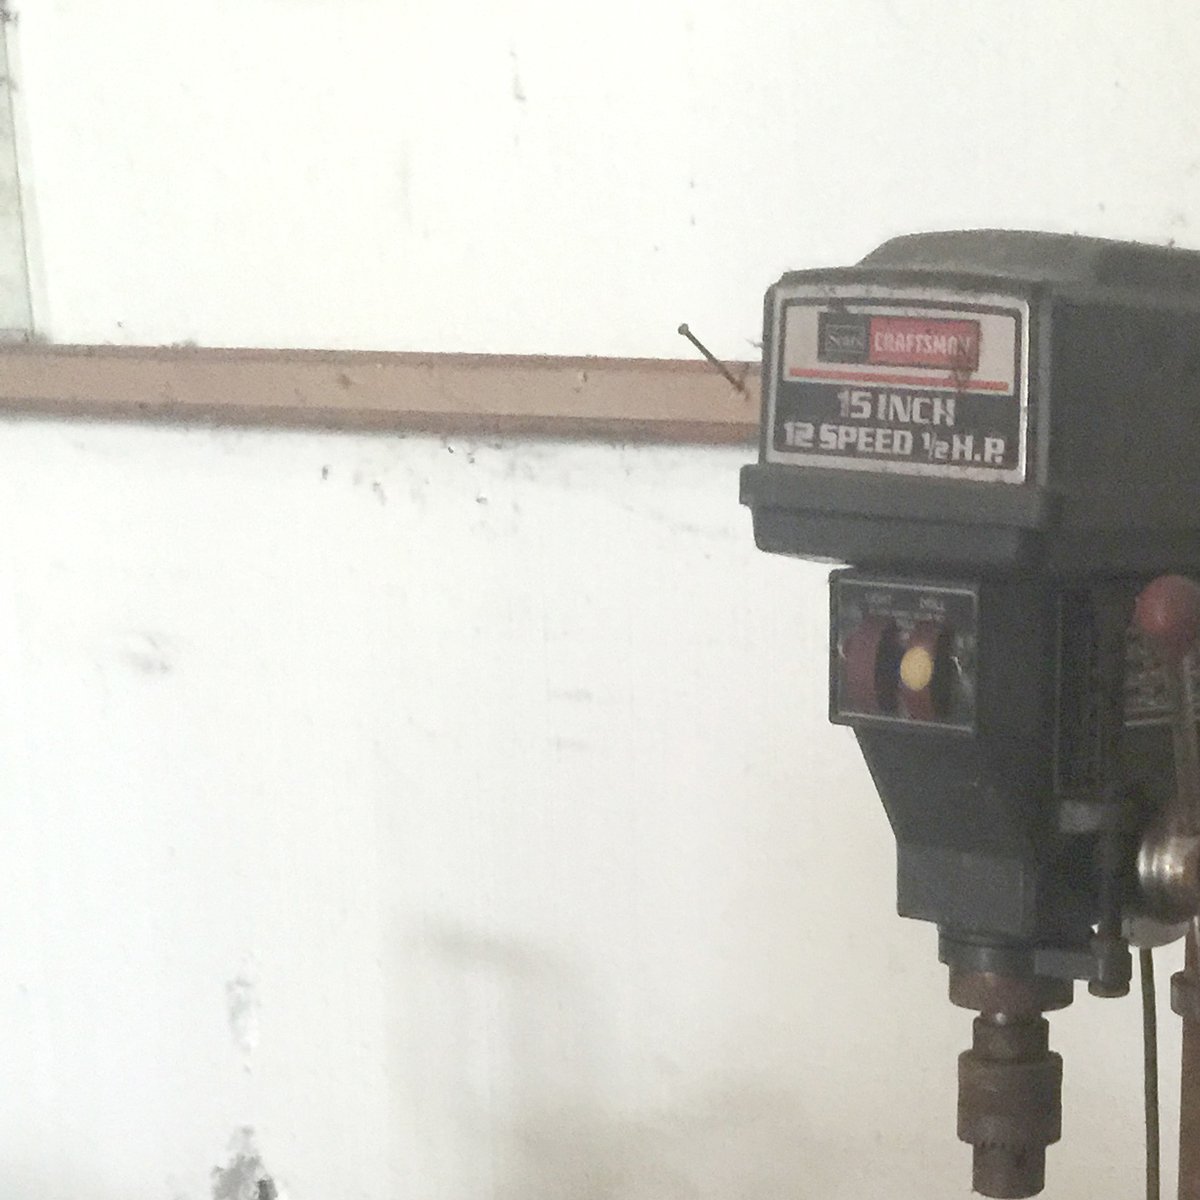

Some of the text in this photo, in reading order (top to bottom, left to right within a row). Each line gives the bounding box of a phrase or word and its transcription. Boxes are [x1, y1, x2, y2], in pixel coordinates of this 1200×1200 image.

[874, 331, 971, 355] CRAFTSMAN
[837, 389, 956, 426] 15 INCH
[784, 421, 815, 448] 12
[819, 423, 914, 455] SPEED
